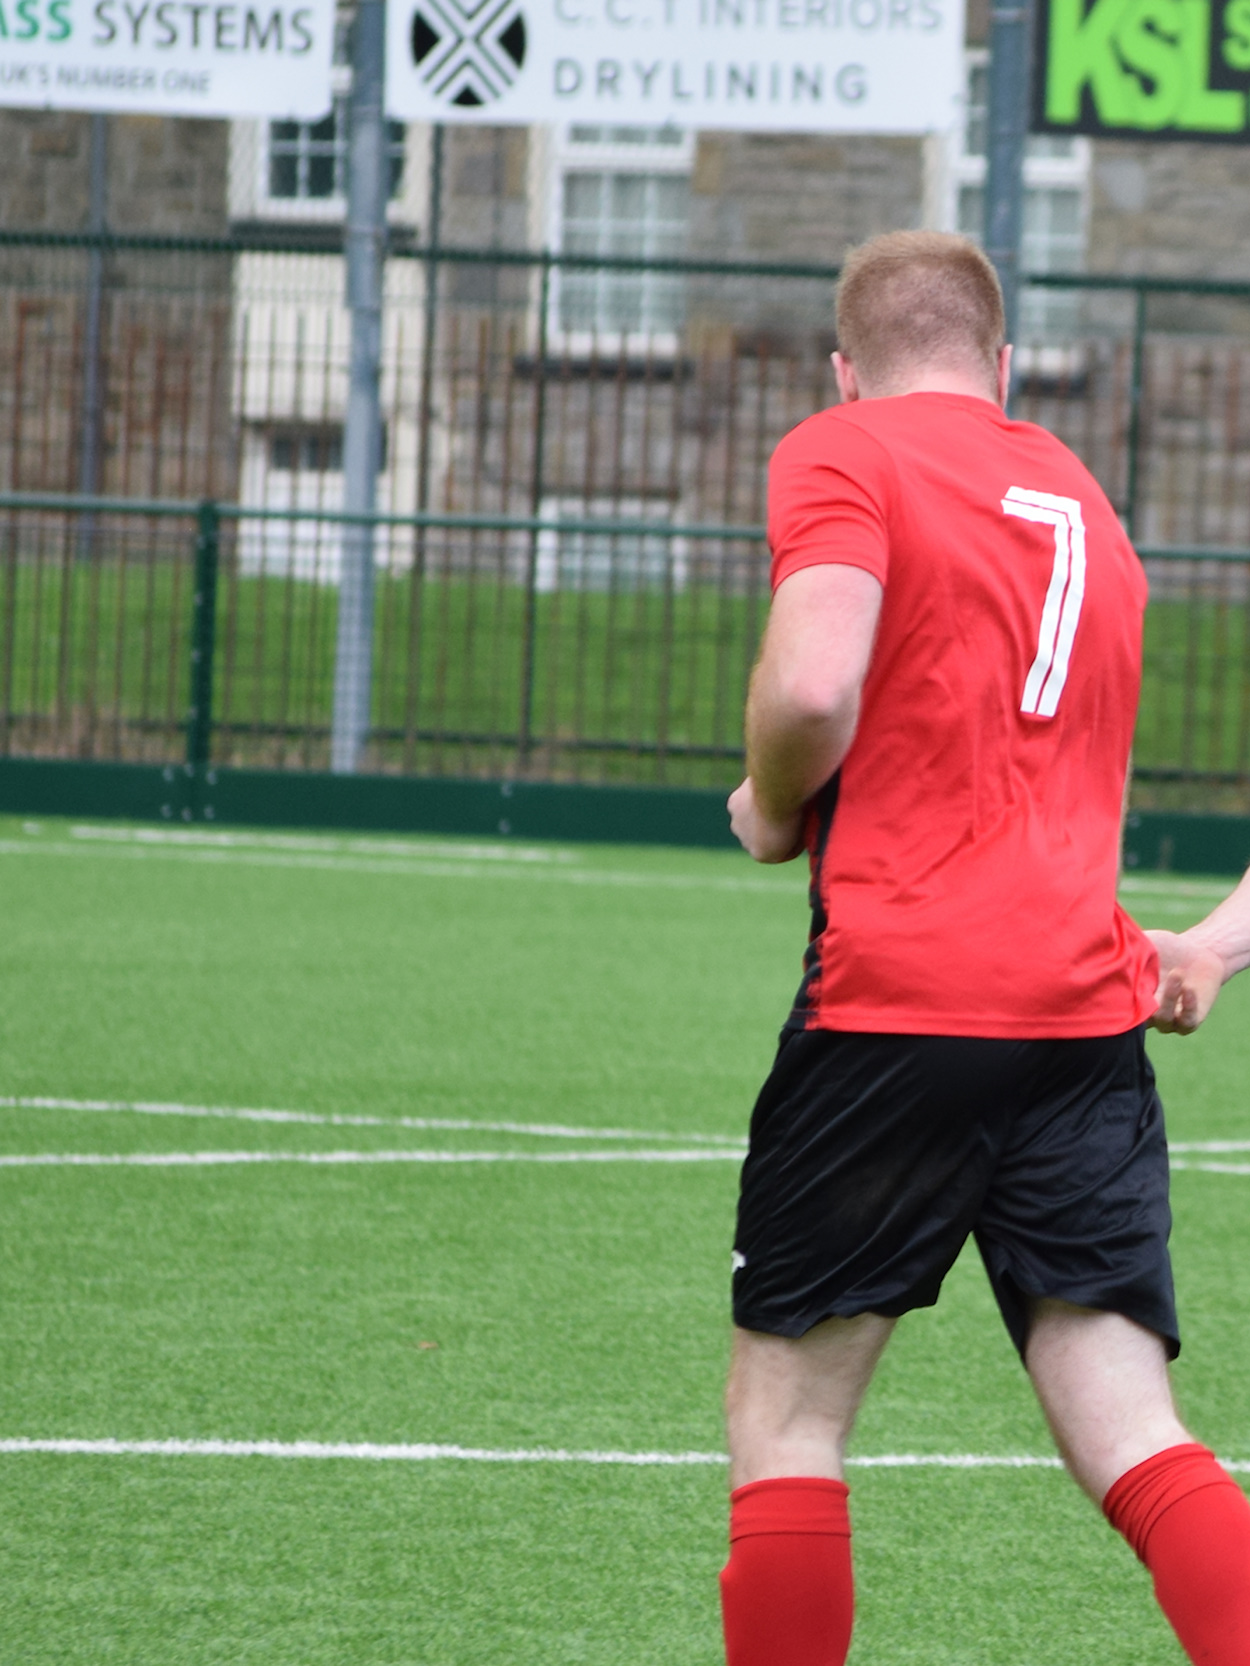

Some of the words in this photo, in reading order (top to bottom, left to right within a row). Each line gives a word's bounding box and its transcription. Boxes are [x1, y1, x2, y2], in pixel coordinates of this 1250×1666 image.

[93, 0, 313, 53] SYSTEMS
[699, 0, 944, 32] INTERIORS
[57, 65, 156, 92] NUMBER
[163, 69, 211, 96] ONE
[553, 59, 868, 102] DRYLINING
[1044, 0, 1246, 130] KSL
[1000, 485, 1087, 718] 7
